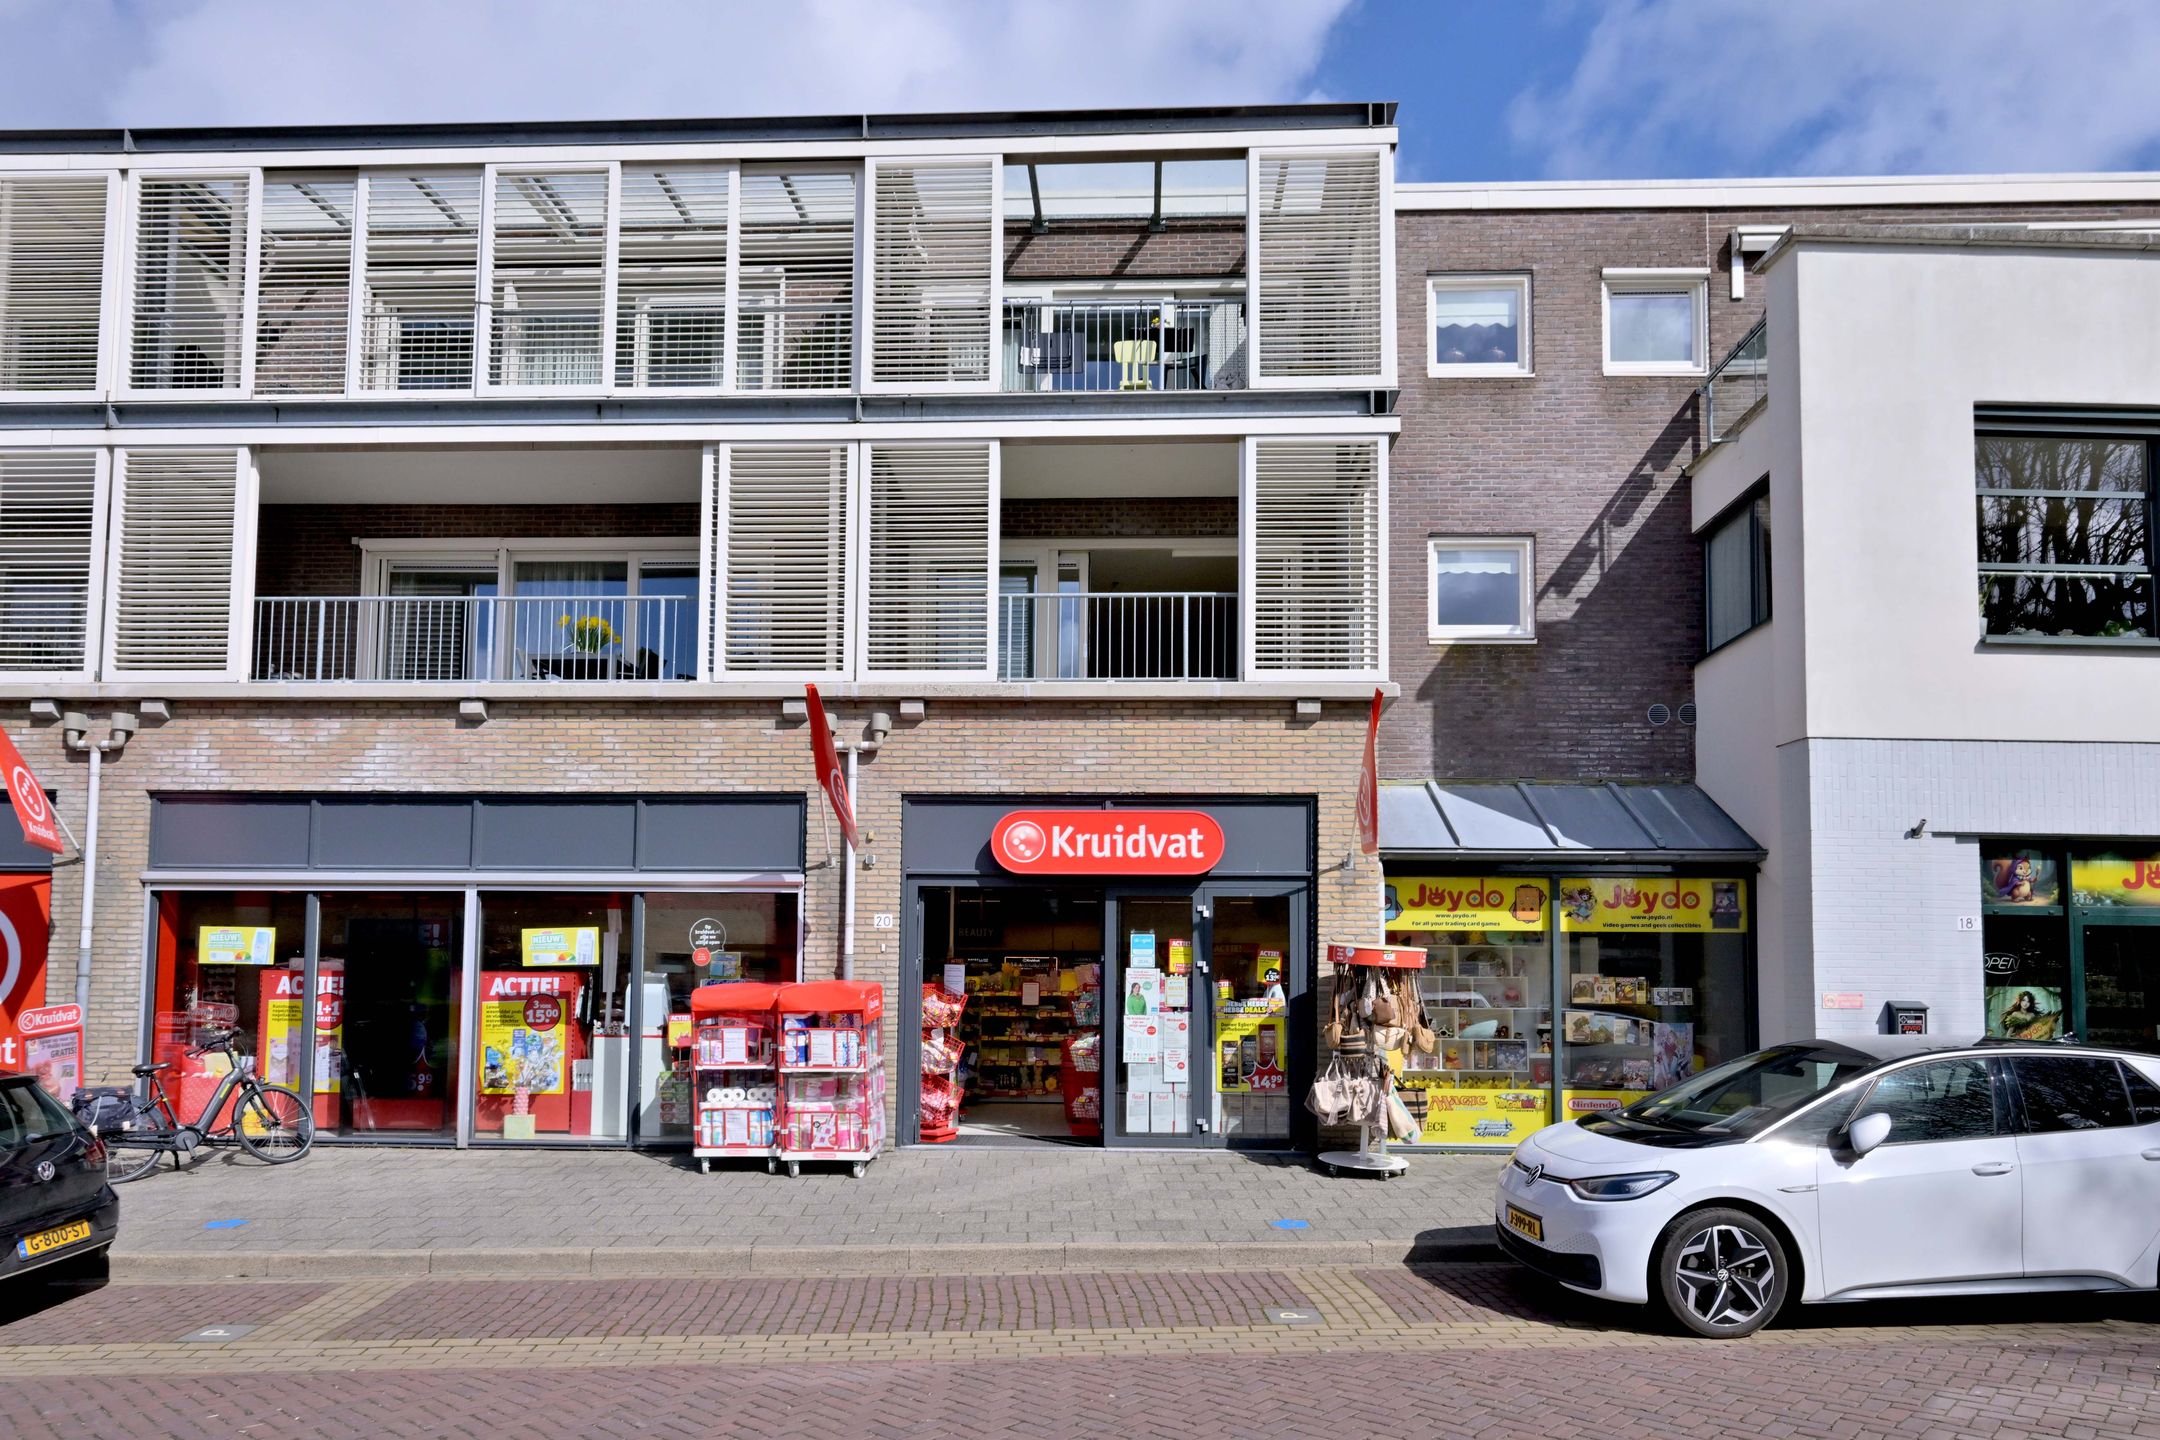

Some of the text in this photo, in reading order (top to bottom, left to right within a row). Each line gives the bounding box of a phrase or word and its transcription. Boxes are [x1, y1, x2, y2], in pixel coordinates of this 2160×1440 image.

[1052, 825, 1204, 858] Kruidvat
[1408, 879, 1504, 911] Joydo
[1603, 880, 1700, 914] Joydo
[876, 916, 890, 926] 20
[958, 928, 994, 937] BEAUTY
[276, 976, 344, 996] ACIE!
[489, 976, 560, 996] ACTIE!
[316, 1001, 340, 1016] 1+1
[526, 1009, 558, 1024] 15.00
[1244, 1006, 1266, 1014] DEALS
[34, 1009, 77, 1026] Kruidvat
[1252, 1075, 1282, 1088] 14.99
[1428, 1096, 1488, 1112] MAGIC
[1572, 1100, 1618, 1108] Nintendo
[30, 1222, 86, 1251] G-800-ST
